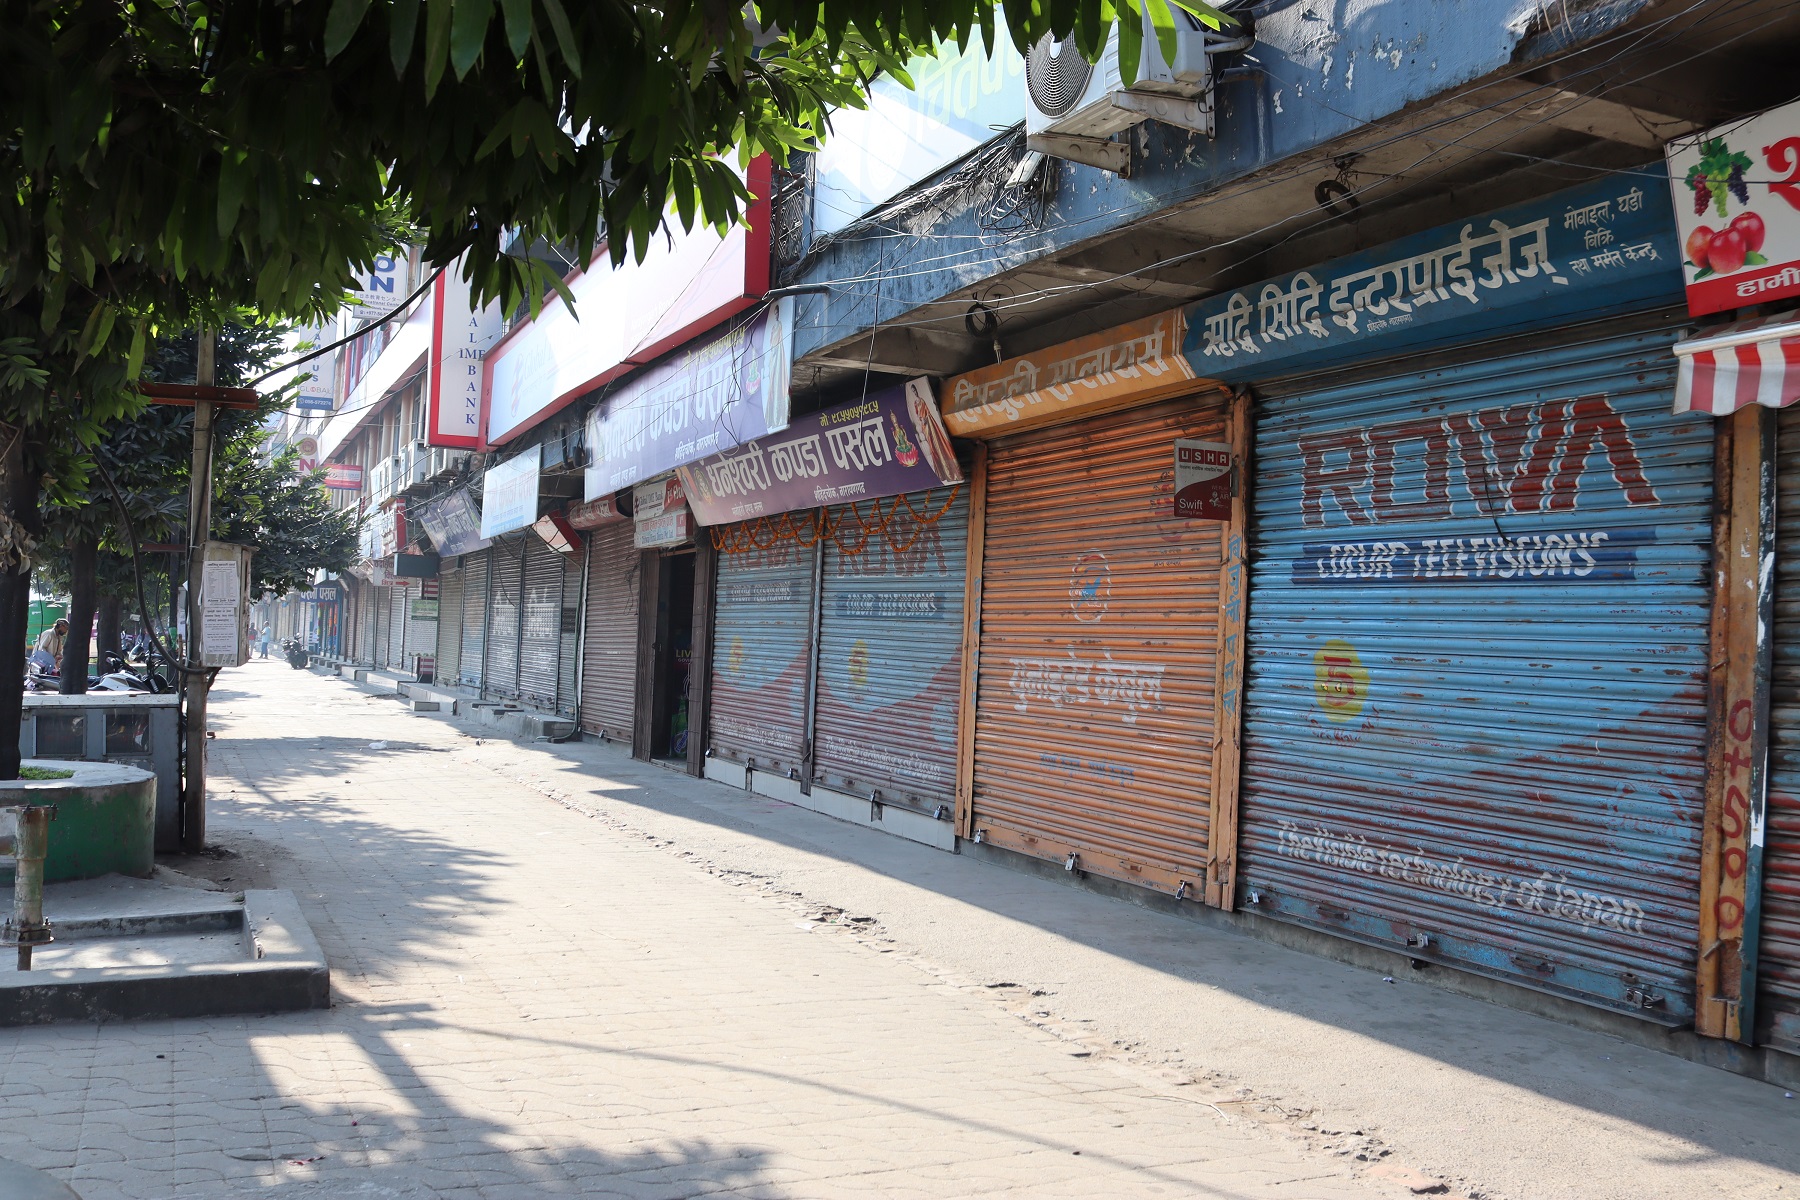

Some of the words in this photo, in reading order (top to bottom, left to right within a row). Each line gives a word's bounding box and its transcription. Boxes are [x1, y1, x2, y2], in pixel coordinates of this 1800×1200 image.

[1617, 187, 1643, 213] घडी
[1569, 259, 1592, 276] तथा
[312, 322, 321, 382] CAMUS
[465, 364, 477, 425] BANK
[650, 374, 692, 441] कपडा
[696, 348, 745, 421] पसल
[768, 433, 829, 483] कपडा
[825, 416, 892, 473] पसल
[1181, 450, 1228, 464] USHA
[1179, 498, 1203, 510] Swift
[1316, 541, 1411, 579] COLOR
[1412, 531, 1610, 579] TELEVISIONS
[1277, 819, 1312, 861] The
[1376, 845, 1513, 909] technology
[1548, 875, 1645, 934] Japan
